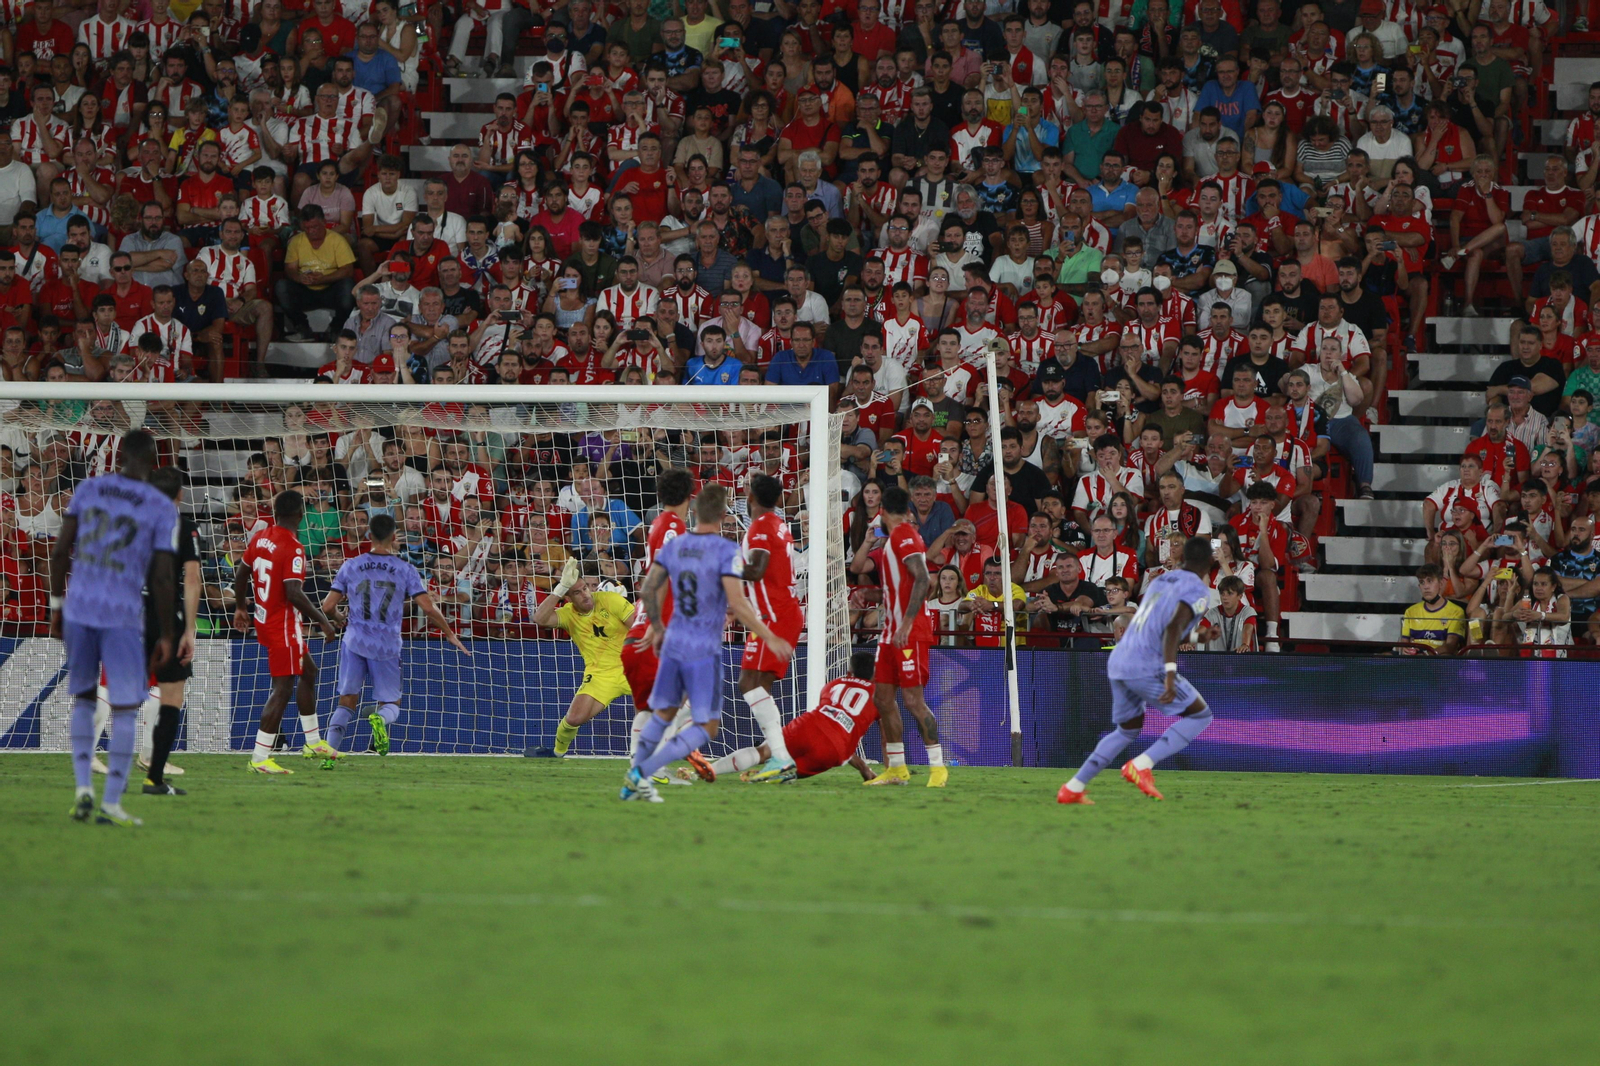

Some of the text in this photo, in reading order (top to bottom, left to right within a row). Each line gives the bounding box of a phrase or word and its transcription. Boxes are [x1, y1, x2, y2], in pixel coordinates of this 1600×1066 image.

[79, 505, 138, 573] 22
[359, 561, 389, 572] LUCAS
[355, 578, 397, 624] 17
[677, 570, 698, 618] 8
[829, 683, 869, 716] 10
